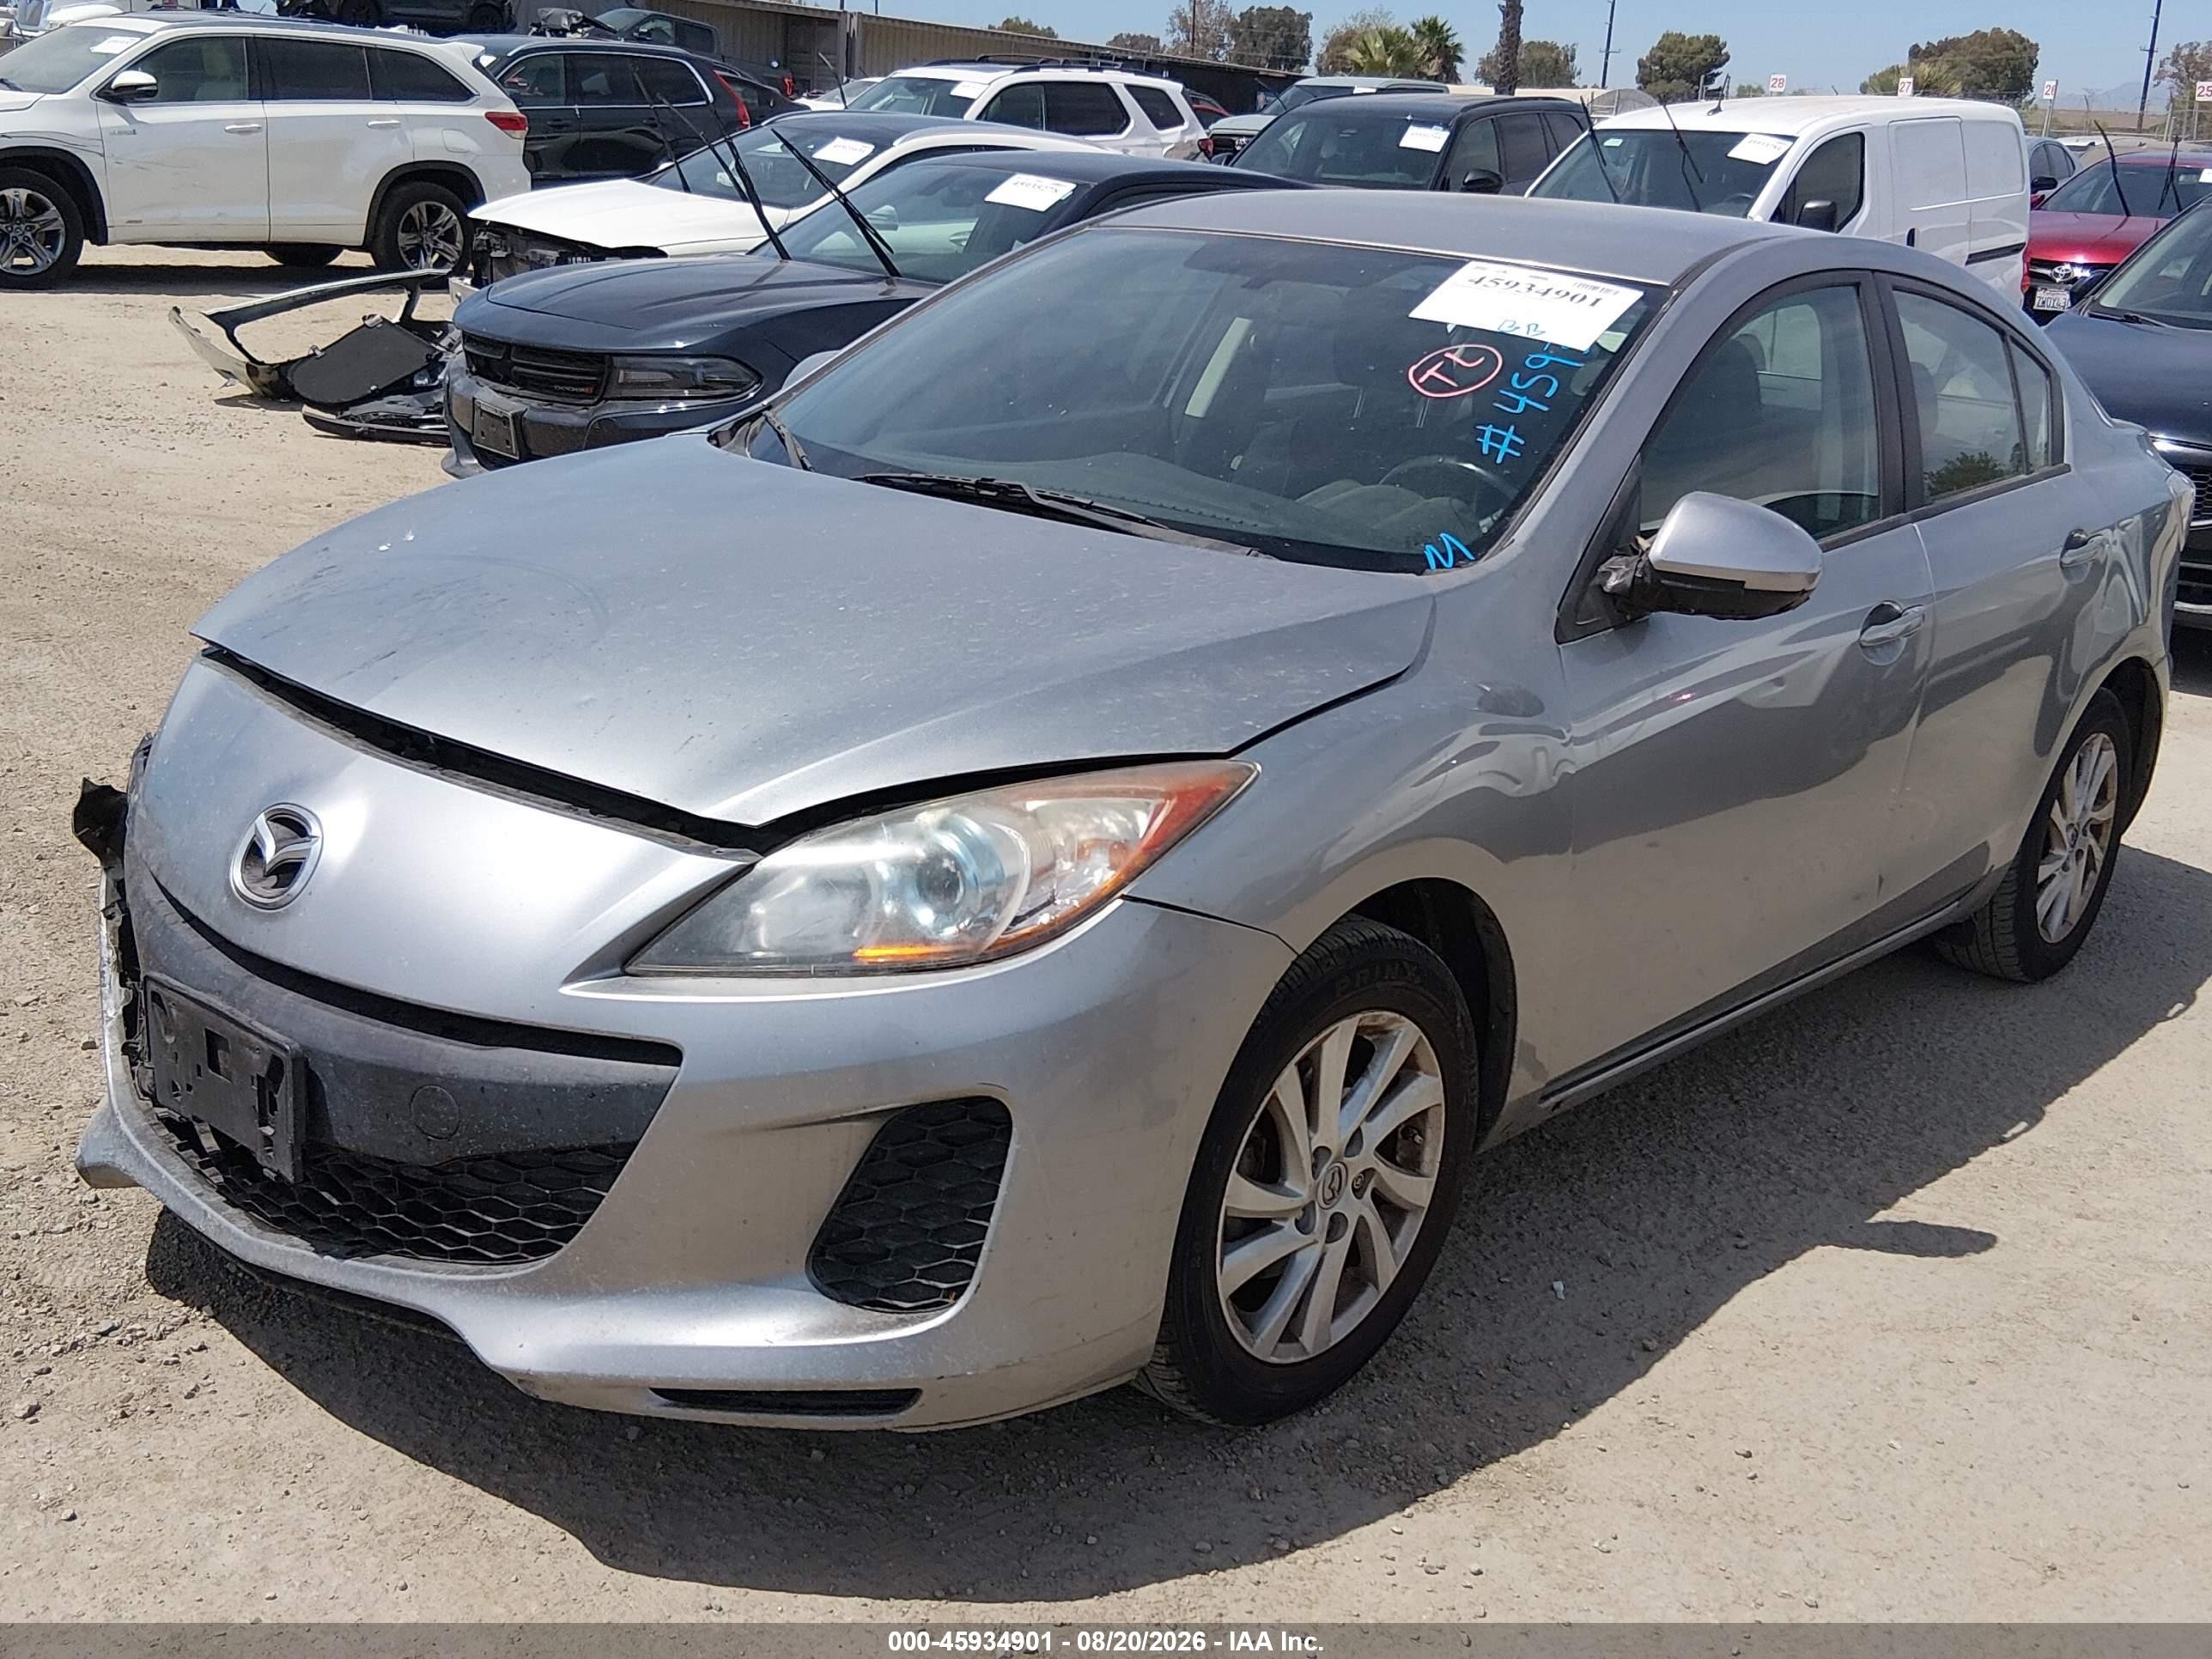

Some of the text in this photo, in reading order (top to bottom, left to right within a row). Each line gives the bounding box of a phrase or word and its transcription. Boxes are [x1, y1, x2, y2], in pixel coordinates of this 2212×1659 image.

[1771, 77, 1784, 88] 28
[1899, 81, 1911, 93] 27
[2197, 85, 2212, 97] 25
[1468, 275, 1602, 307] 45934901
